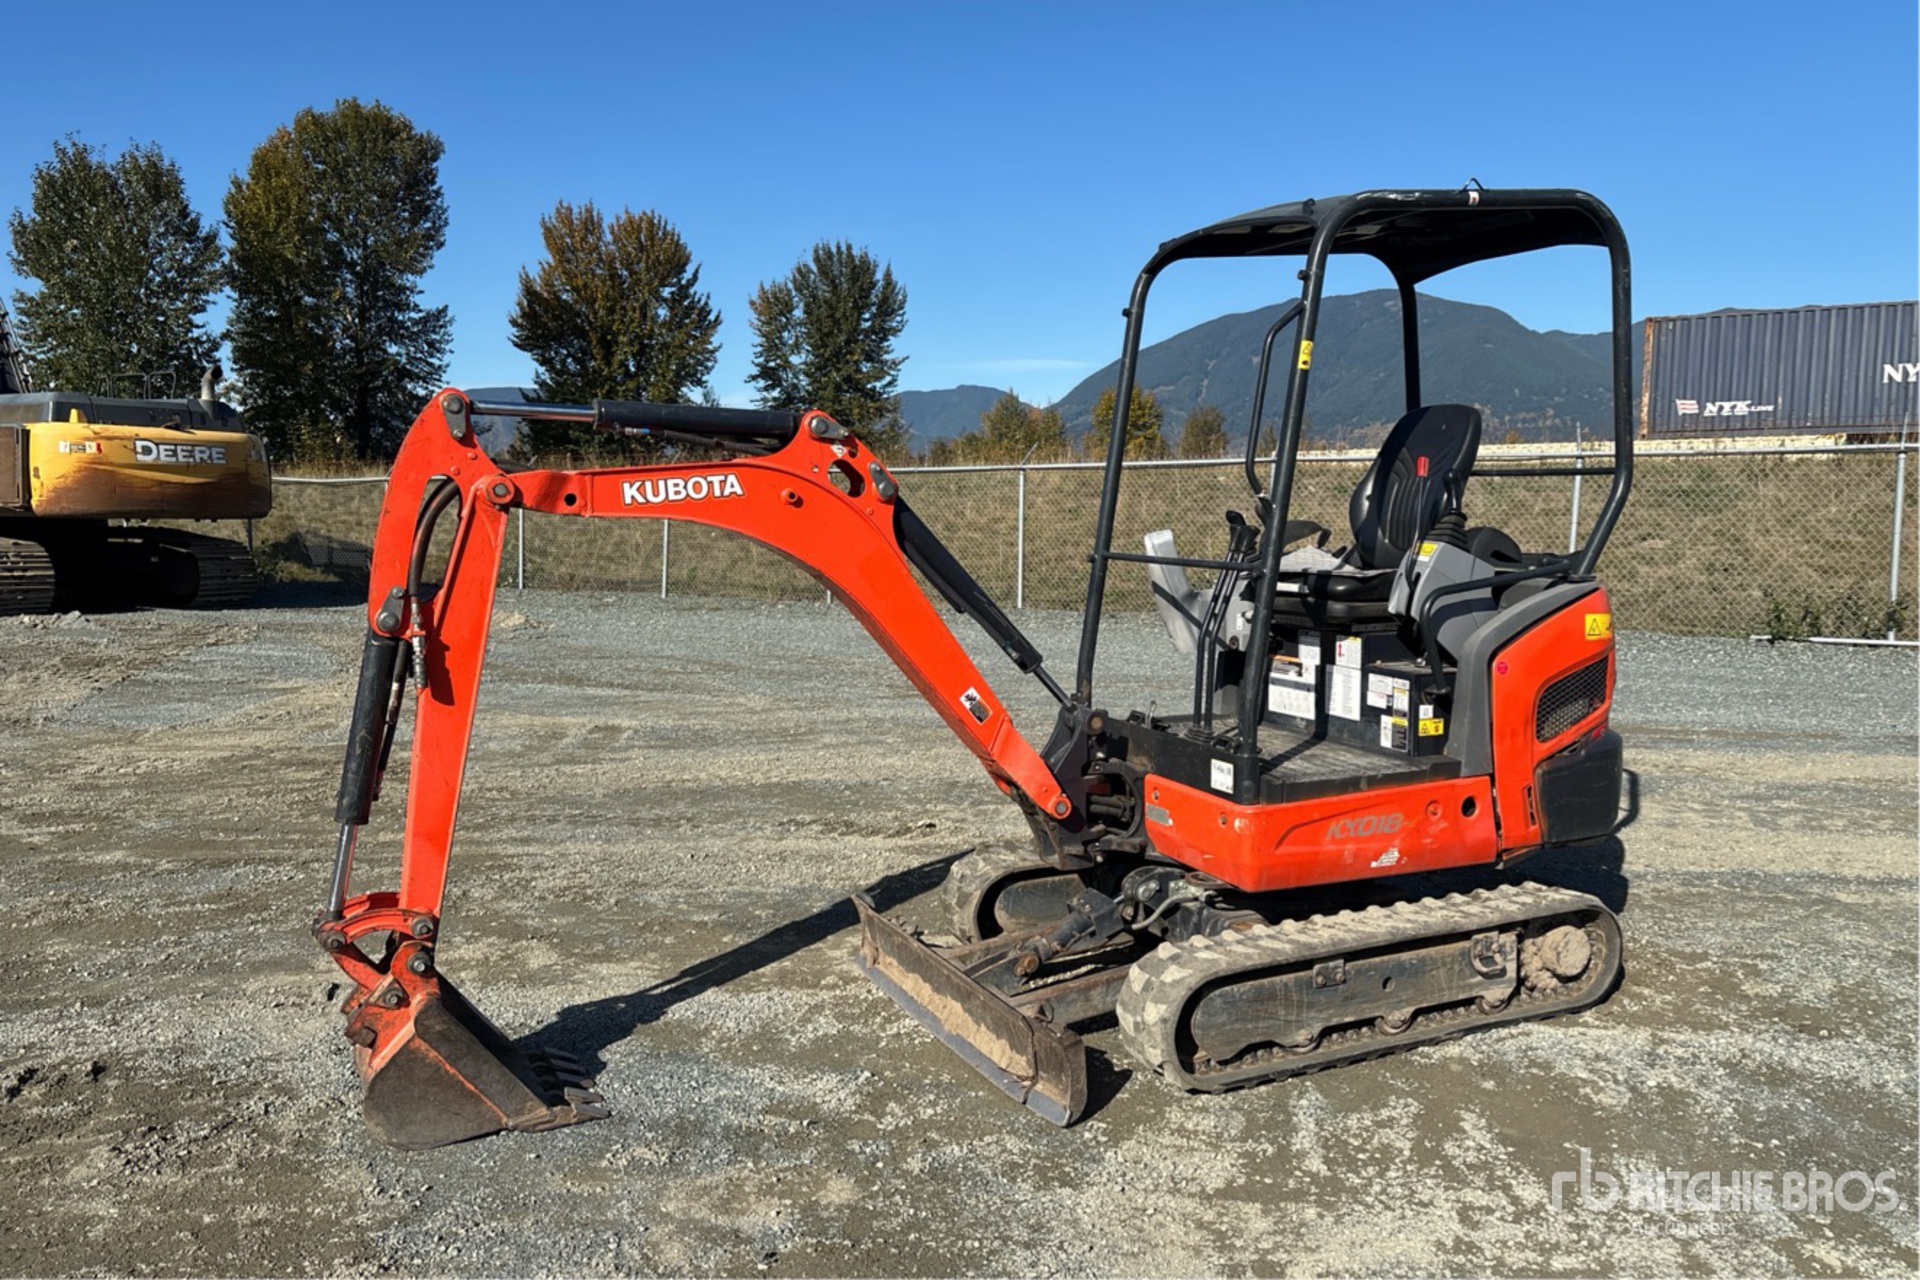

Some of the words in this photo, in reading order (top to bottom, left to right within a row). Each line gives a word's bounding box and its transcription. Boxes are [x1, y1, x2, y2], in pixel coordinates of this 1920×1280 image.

[1703, 400, 1752, 416] NYK
[135, 440, 226, 464] DEERE
[622, 473, 744, 505] KUBOTA
